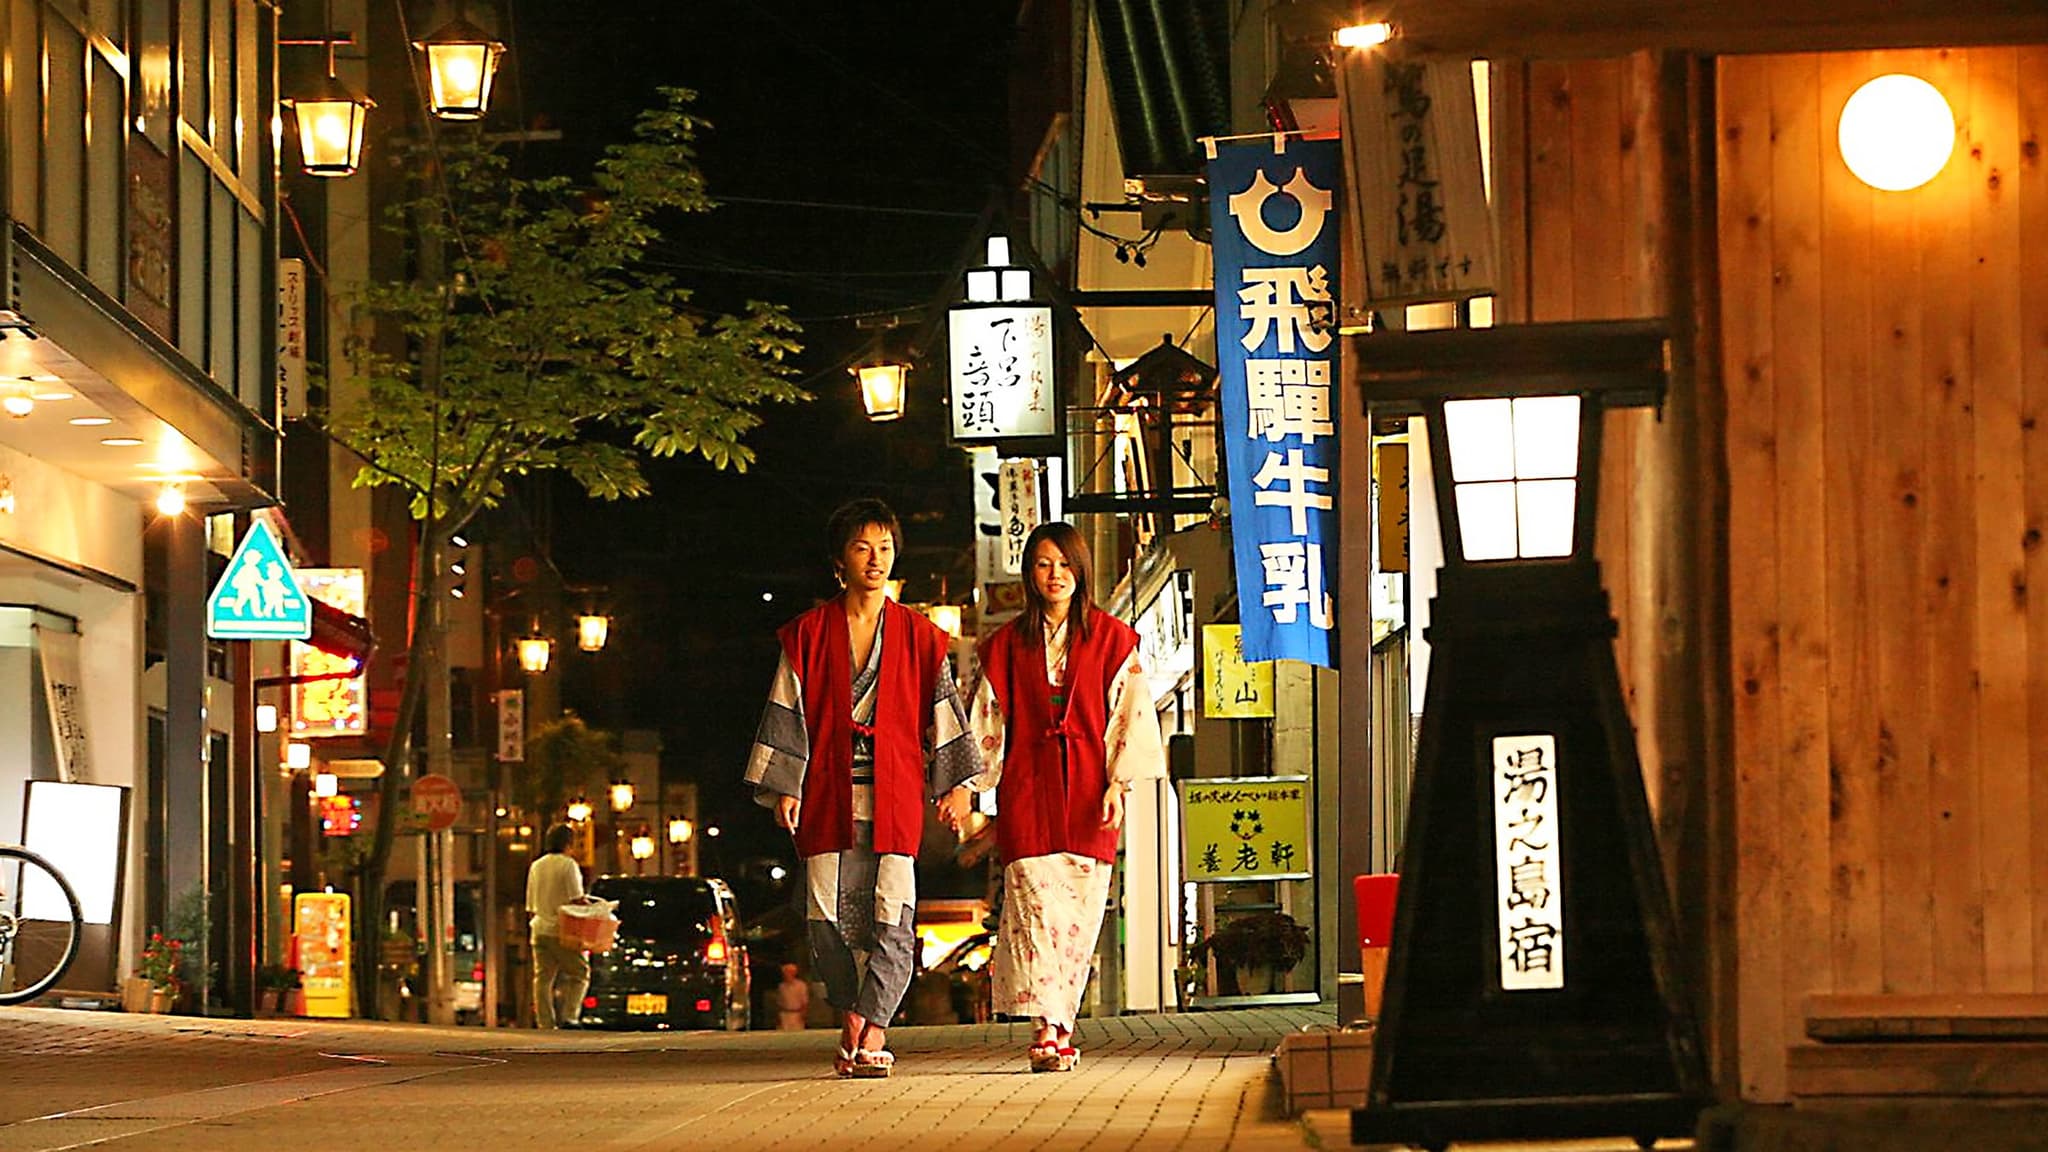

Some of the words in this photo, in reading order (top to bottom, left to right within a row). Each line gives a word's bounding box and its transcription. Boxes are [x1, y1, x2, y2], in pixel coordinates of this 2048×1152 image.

[1197, 840, 1295, 874] 養老軒
[1503, 746, 1558, 973] 湯之島宿
